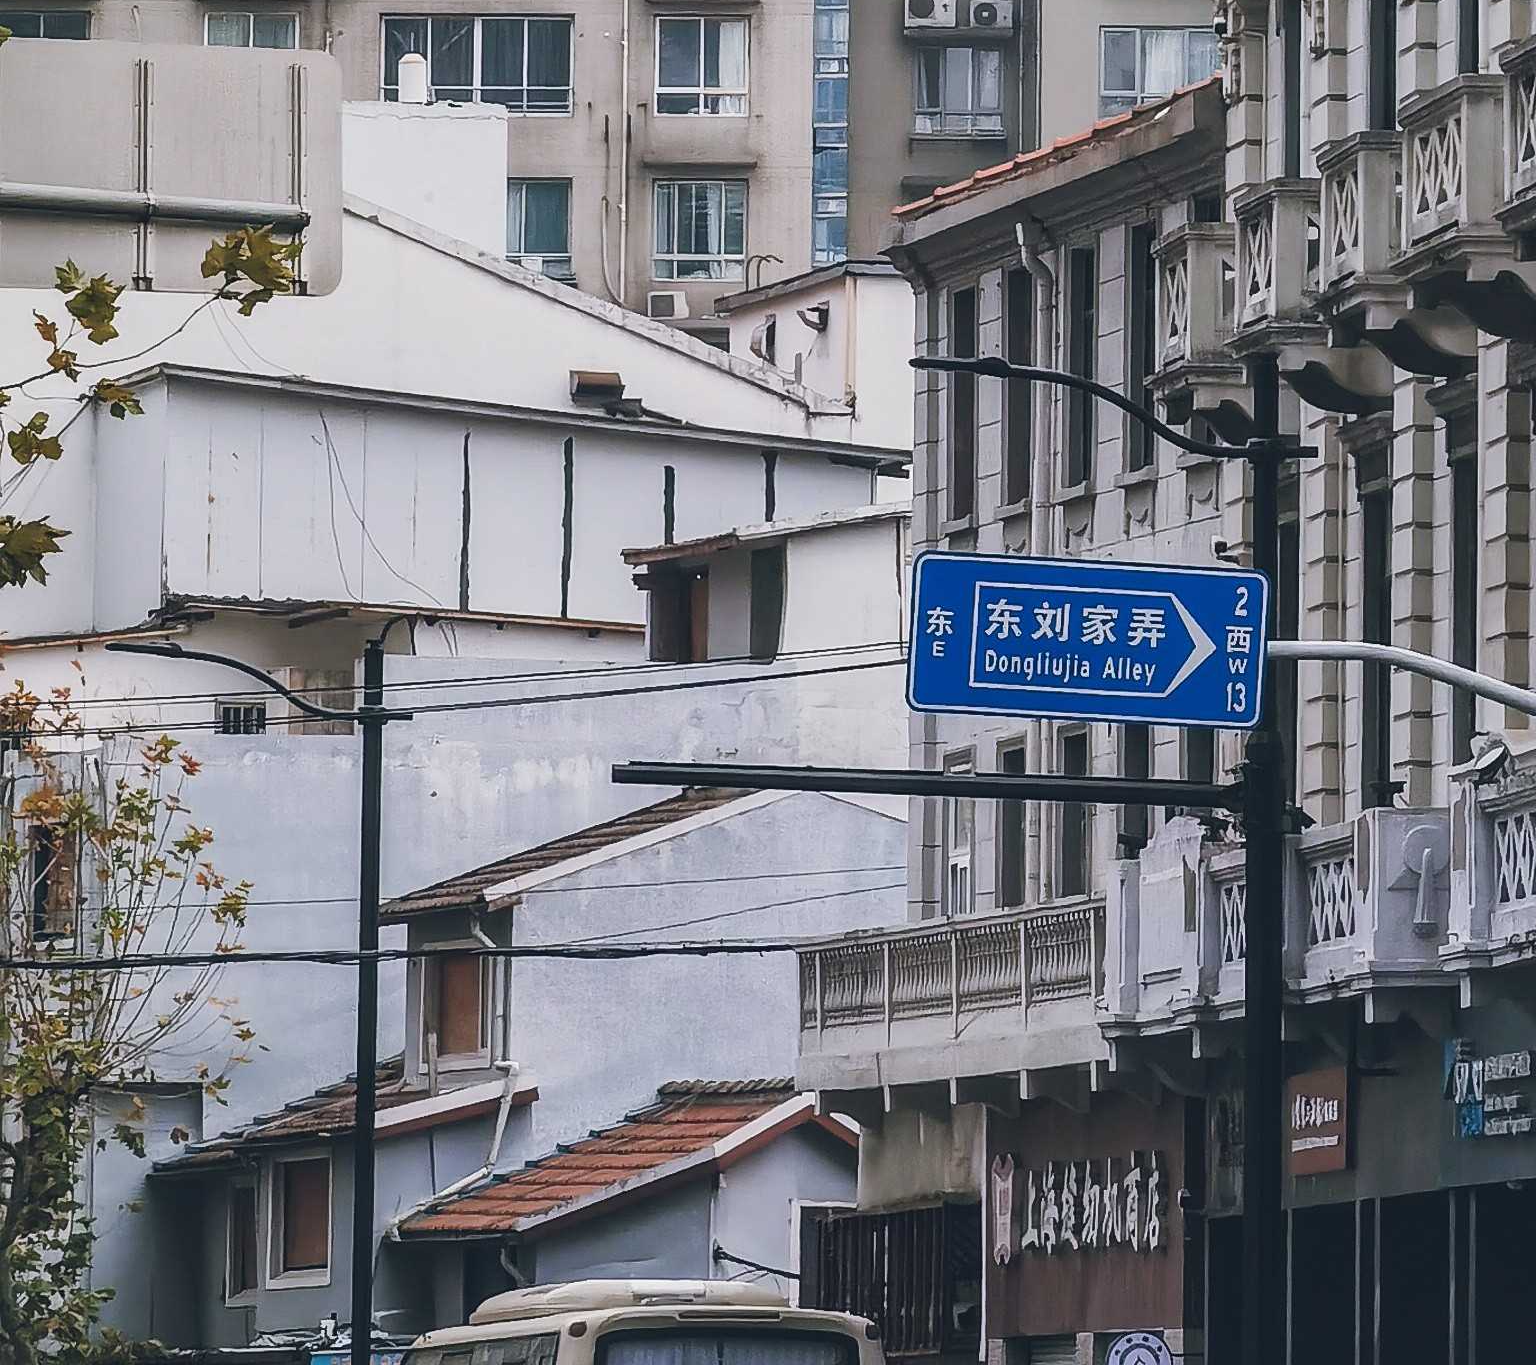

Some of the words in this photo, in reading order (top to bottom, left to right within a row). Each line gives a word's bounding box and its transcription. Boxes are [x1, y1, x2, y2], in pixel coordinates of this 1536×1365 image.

[1235, 586, 1248, 618] 2
[926, 606, 954, 637] 东
[984, 598, 1166, 648] 东刘家弄
[933, 641, 945, 657] E
[1226, 624, 1254, 654] 西
[984, 649, 1090, 684] Dongliujia
[1102, 655, 1156, 686] Alley
[1226, 683, 1246, 713] 13
